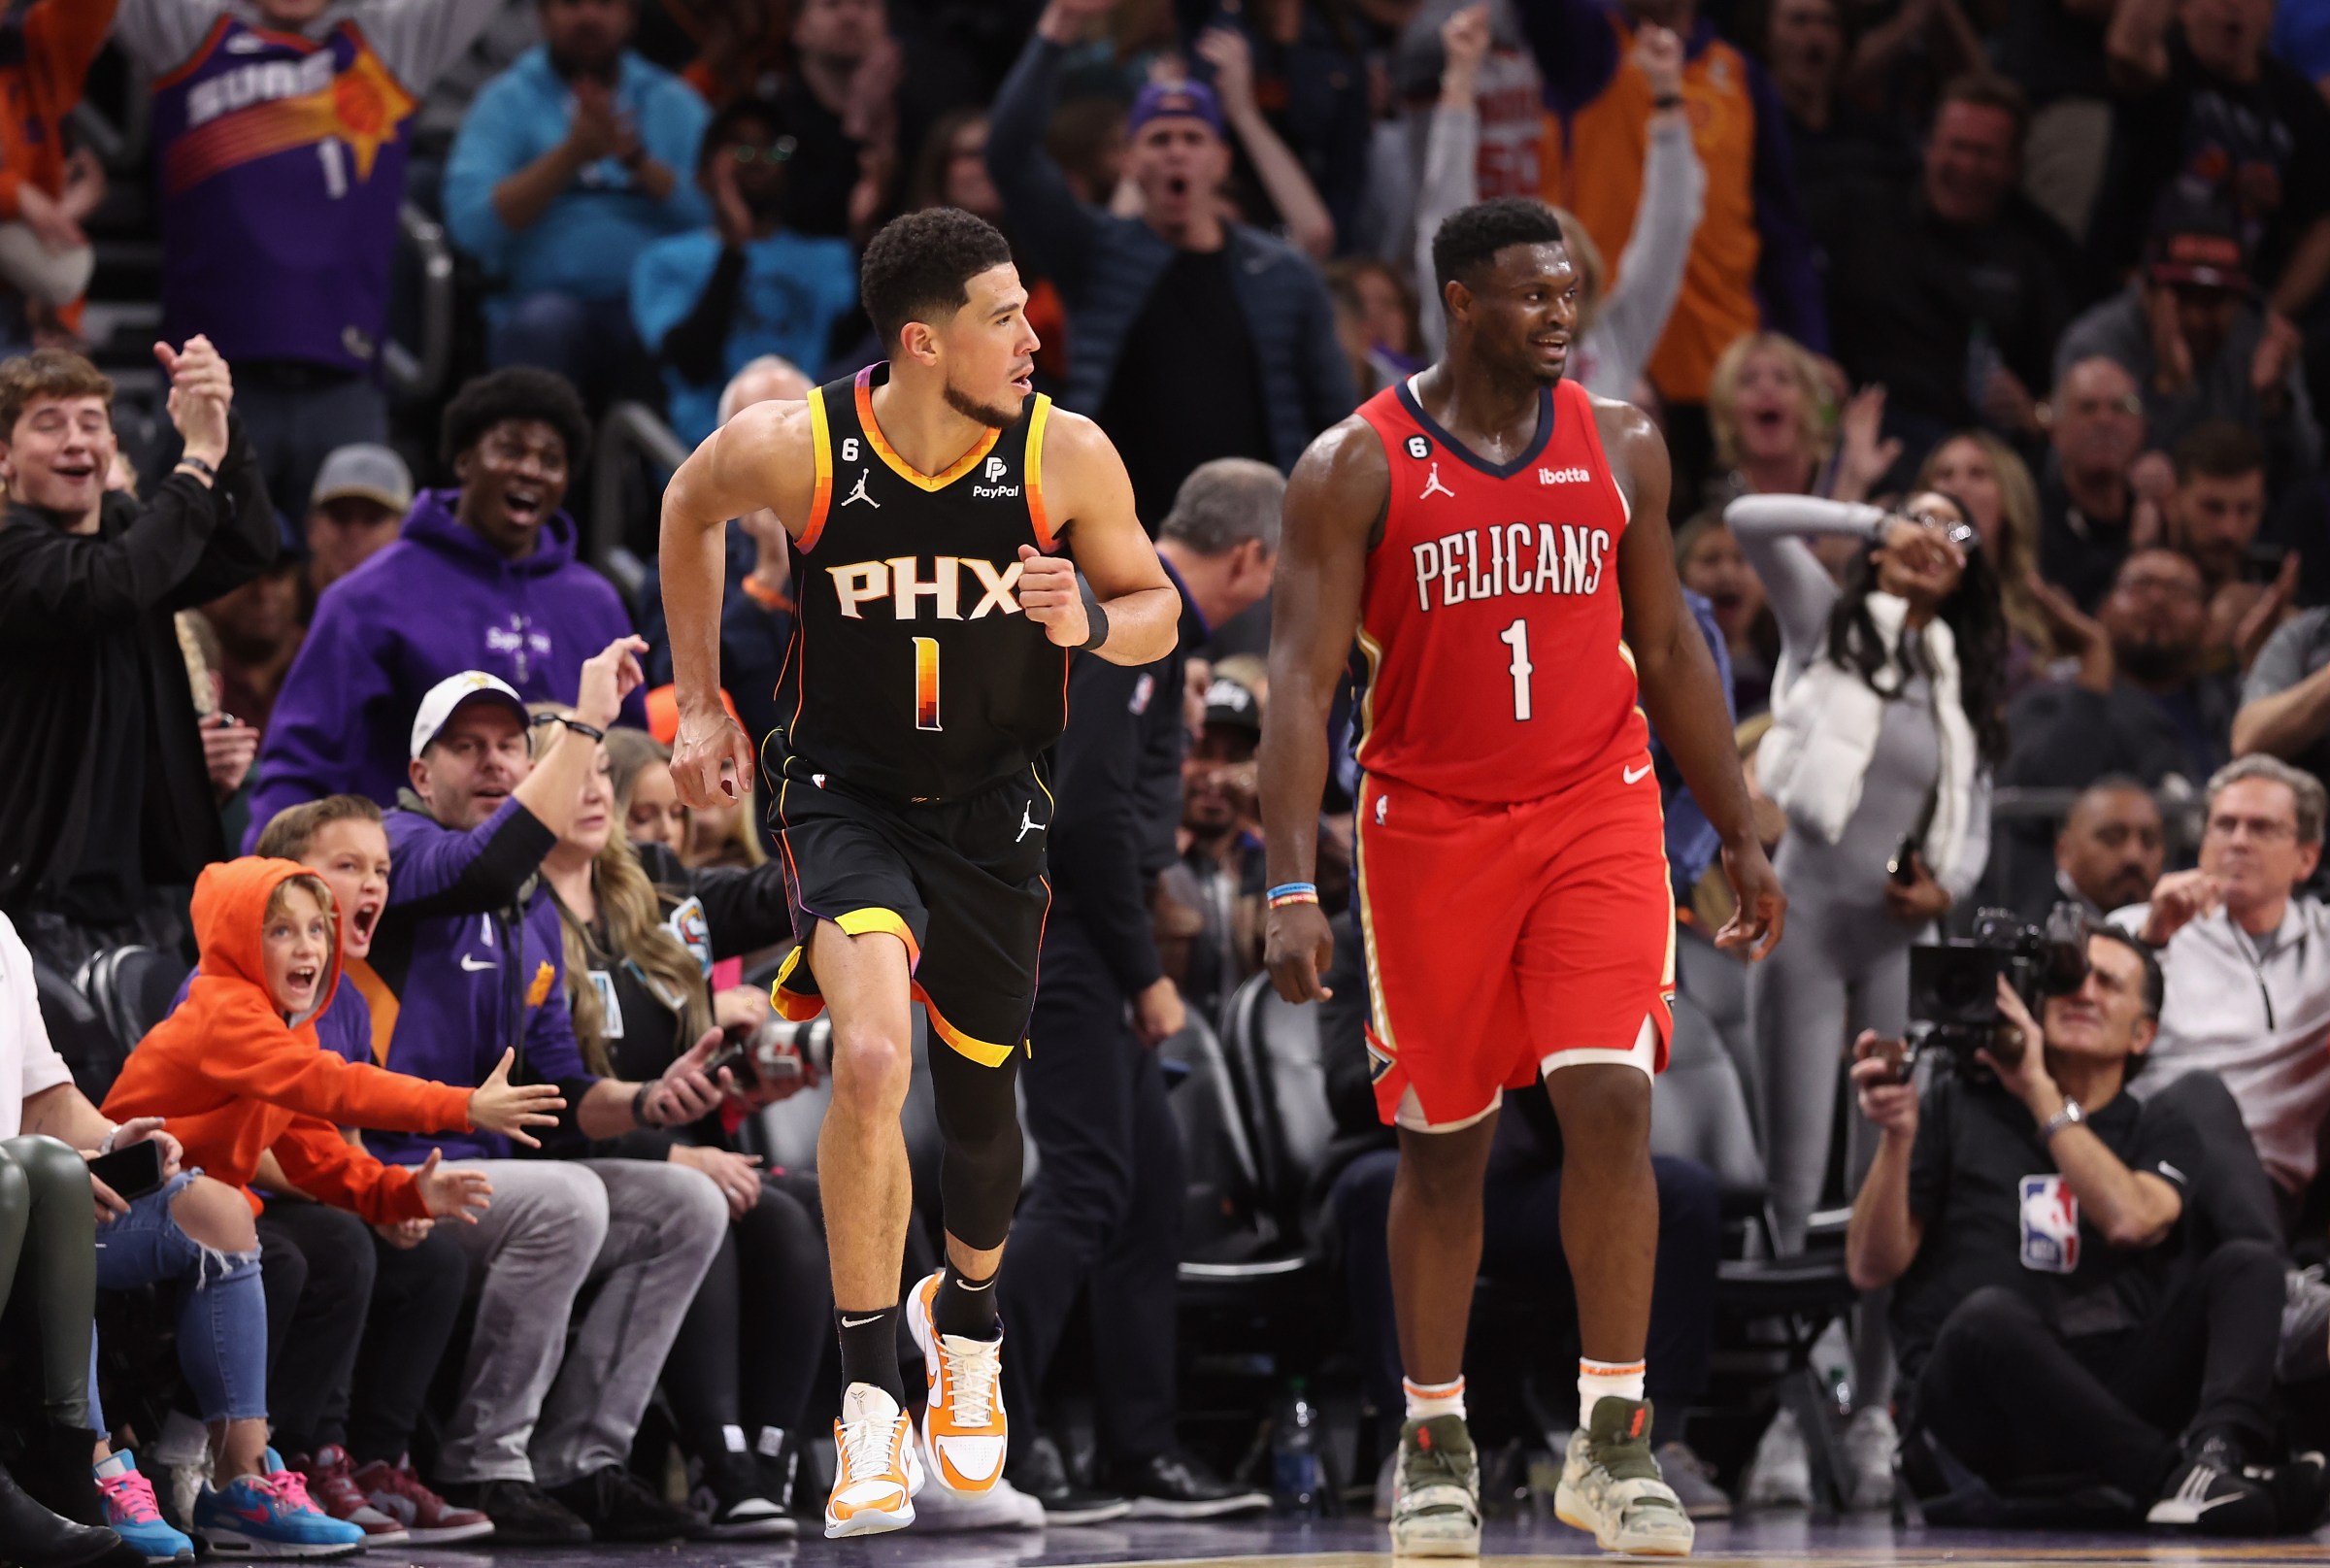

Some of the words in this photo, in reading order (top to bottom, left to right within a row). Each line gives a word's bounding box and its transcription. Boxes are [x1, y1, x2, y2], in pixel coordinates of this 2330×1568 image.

[317, 139, 349, 198] 1
[842, 438, 859, 462] 6
[1408, 436, 1428, 458] 6
[1538, 467, 1590, 484] ibotta
[973, 484, 1018, 499] PayPal
[825, 555, 1024, 620] PHX
[1412, 522, 1610, 613] PELICANS
[912, 636, 943, 731] 1
[1499, 617, 1534, 721] 1
